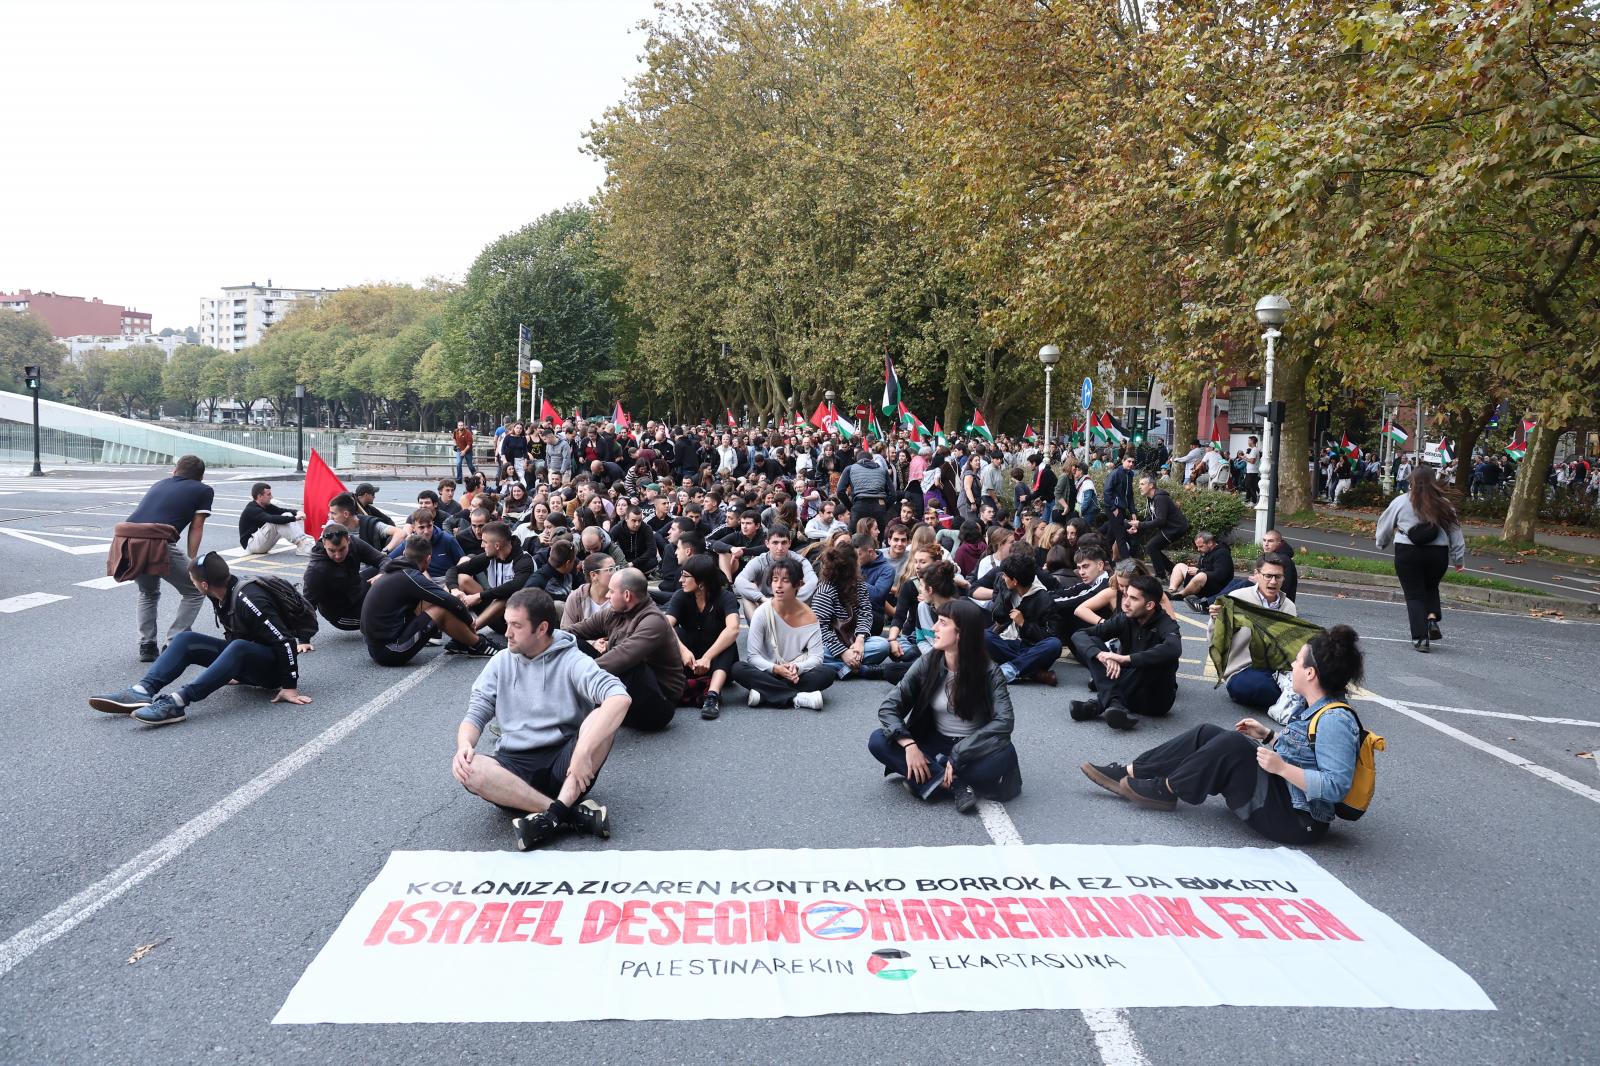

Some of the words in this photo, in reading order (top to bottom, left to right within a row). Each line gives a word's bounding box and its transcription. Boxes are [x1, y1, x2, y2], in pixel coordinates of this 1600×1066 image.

[406, 880, 720, 896] KOLONIZAZIOAREN
[730, 879, 906, 894] KONTRAKO
[916, 876, 1071, 891] BORROKA
[1077, 877, 1122, 889] EZ
[1126, 876, 1173, 889] DA
[1175, 877, 1298, 893] BUKATU
[363, 900, 563, 946] ISRAEL
[579, 899, 800, 945] DESEGIN
[864, 894, 1223, 941] HARREMANAK
[1200, 896, 1365, 941] ETEN
[620, 958, 854, 978] PALESTINAREKIN
[929, 953, 1127, 969] ELKARTASUNA
